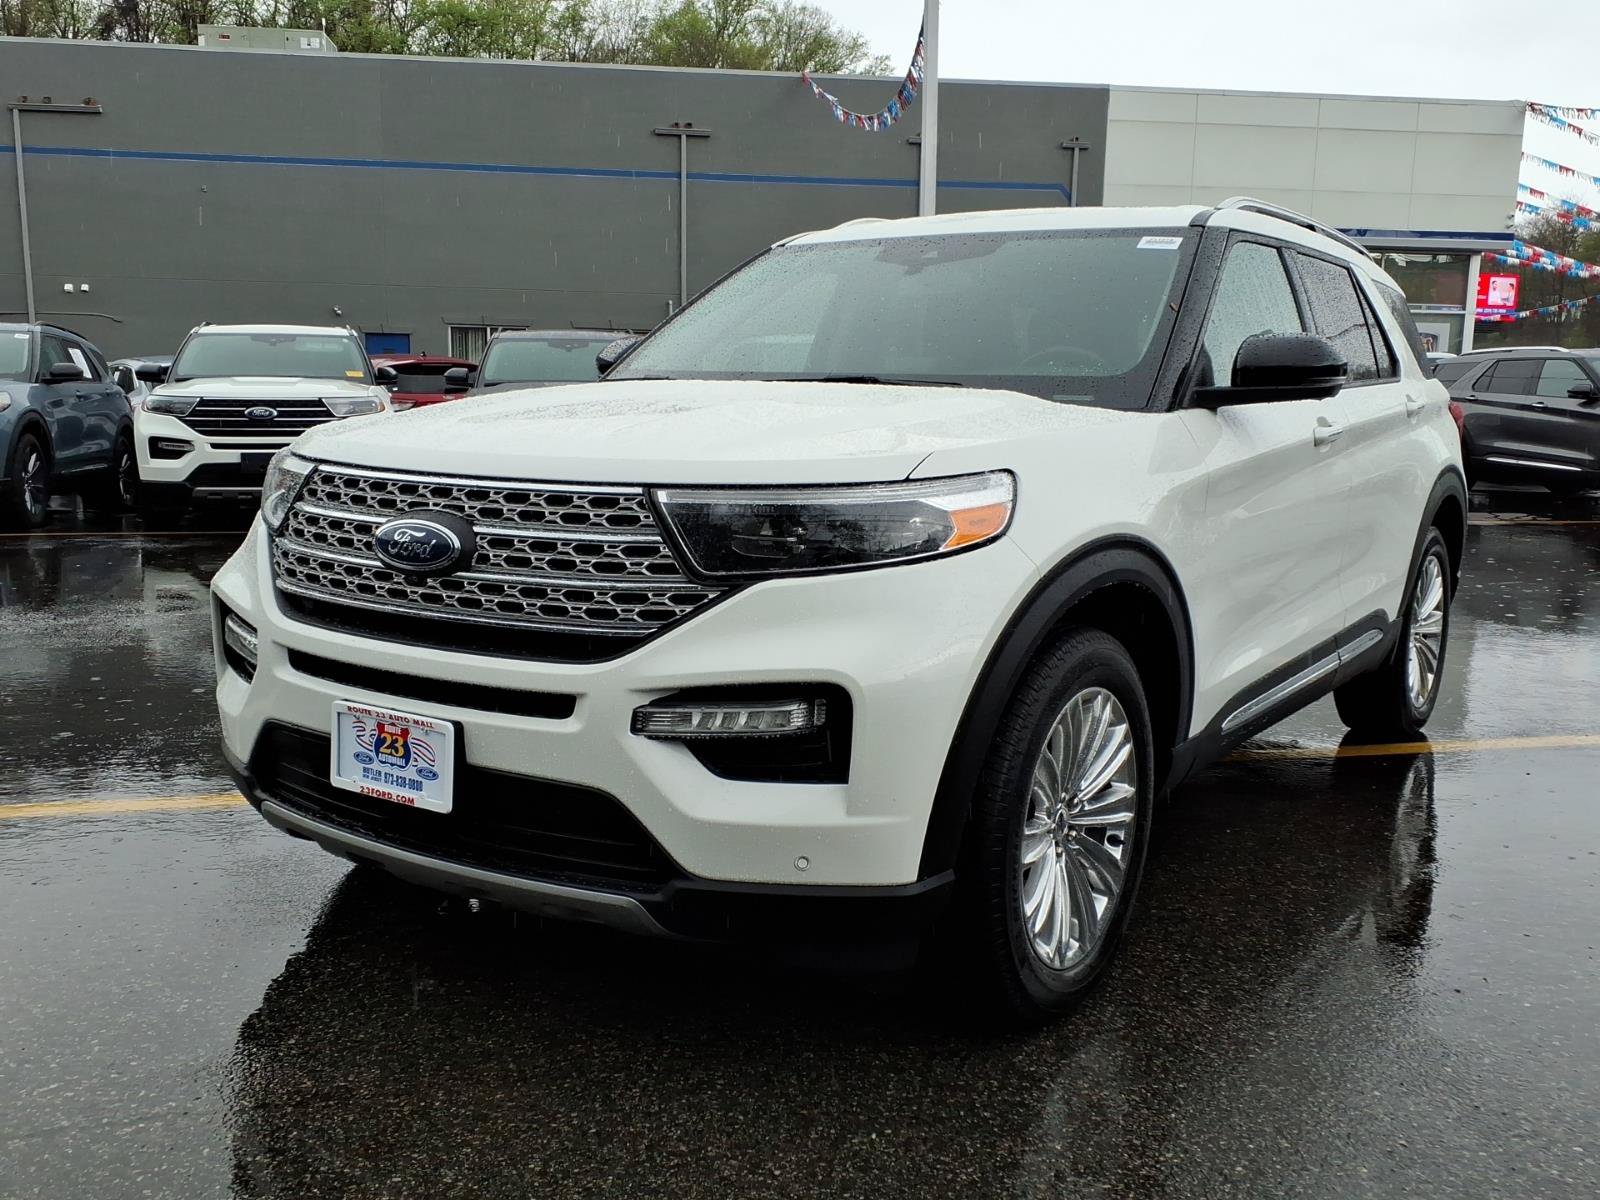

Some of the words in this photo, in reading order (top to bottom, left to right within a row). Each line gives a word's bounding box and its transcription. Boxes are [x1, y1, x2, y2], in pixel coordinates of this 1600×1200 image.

[388, 528, 437, 558] Ford
[347, 705, 373, 716] ROUTE
[375, 711, 386, 719] 23
[388, 712, 410, 724] AUTO
[412, 718, 434, 729] MALL
[385, 724, 402, 735] ROUTE
[379, 732, 405, 757] 23
[362, 766, 382, 778] BUTLER
[360, 785, 415, 806] 23FORD.COM
